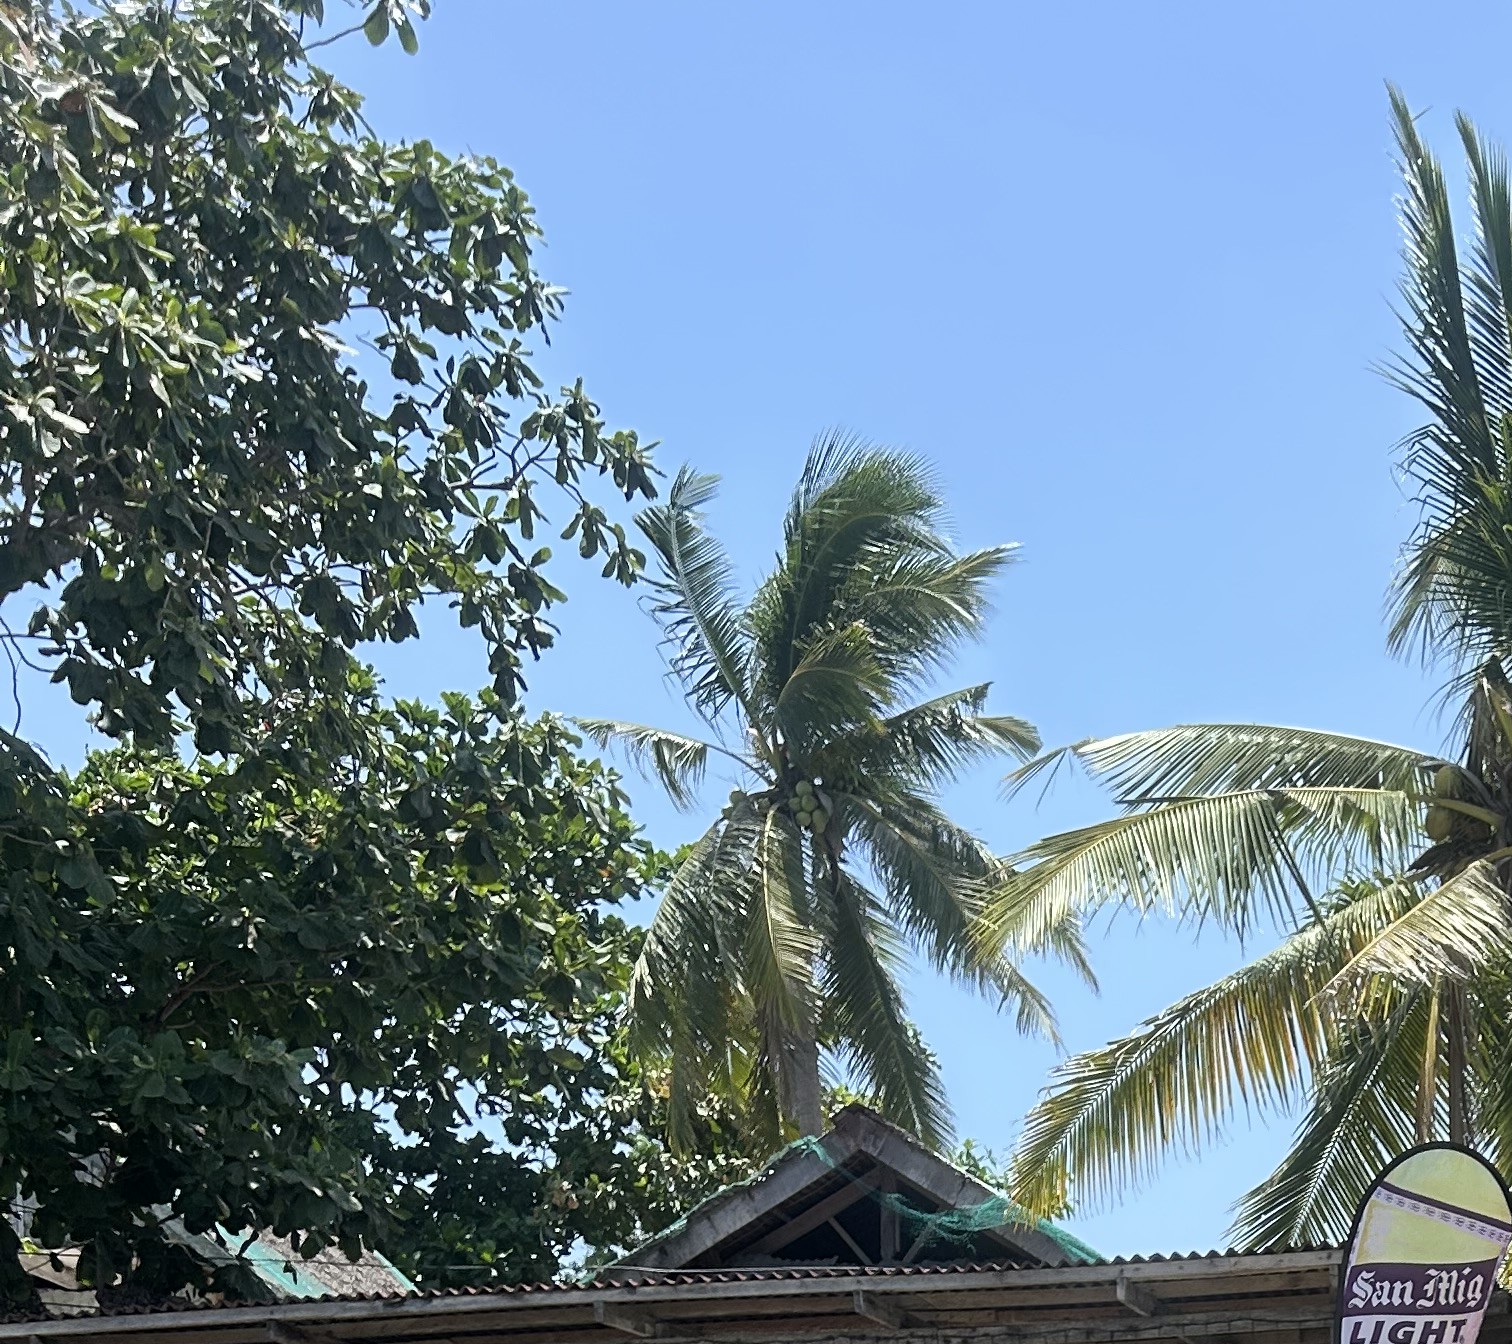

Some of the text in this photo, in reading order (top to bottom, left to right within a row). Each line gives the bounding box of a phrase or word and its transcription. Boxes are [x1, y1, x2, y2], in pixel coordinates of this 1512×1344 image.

[1348, 1267, 1484, 1309] San Mig
[1349, 1319, 1468, 1344] LIGHT
